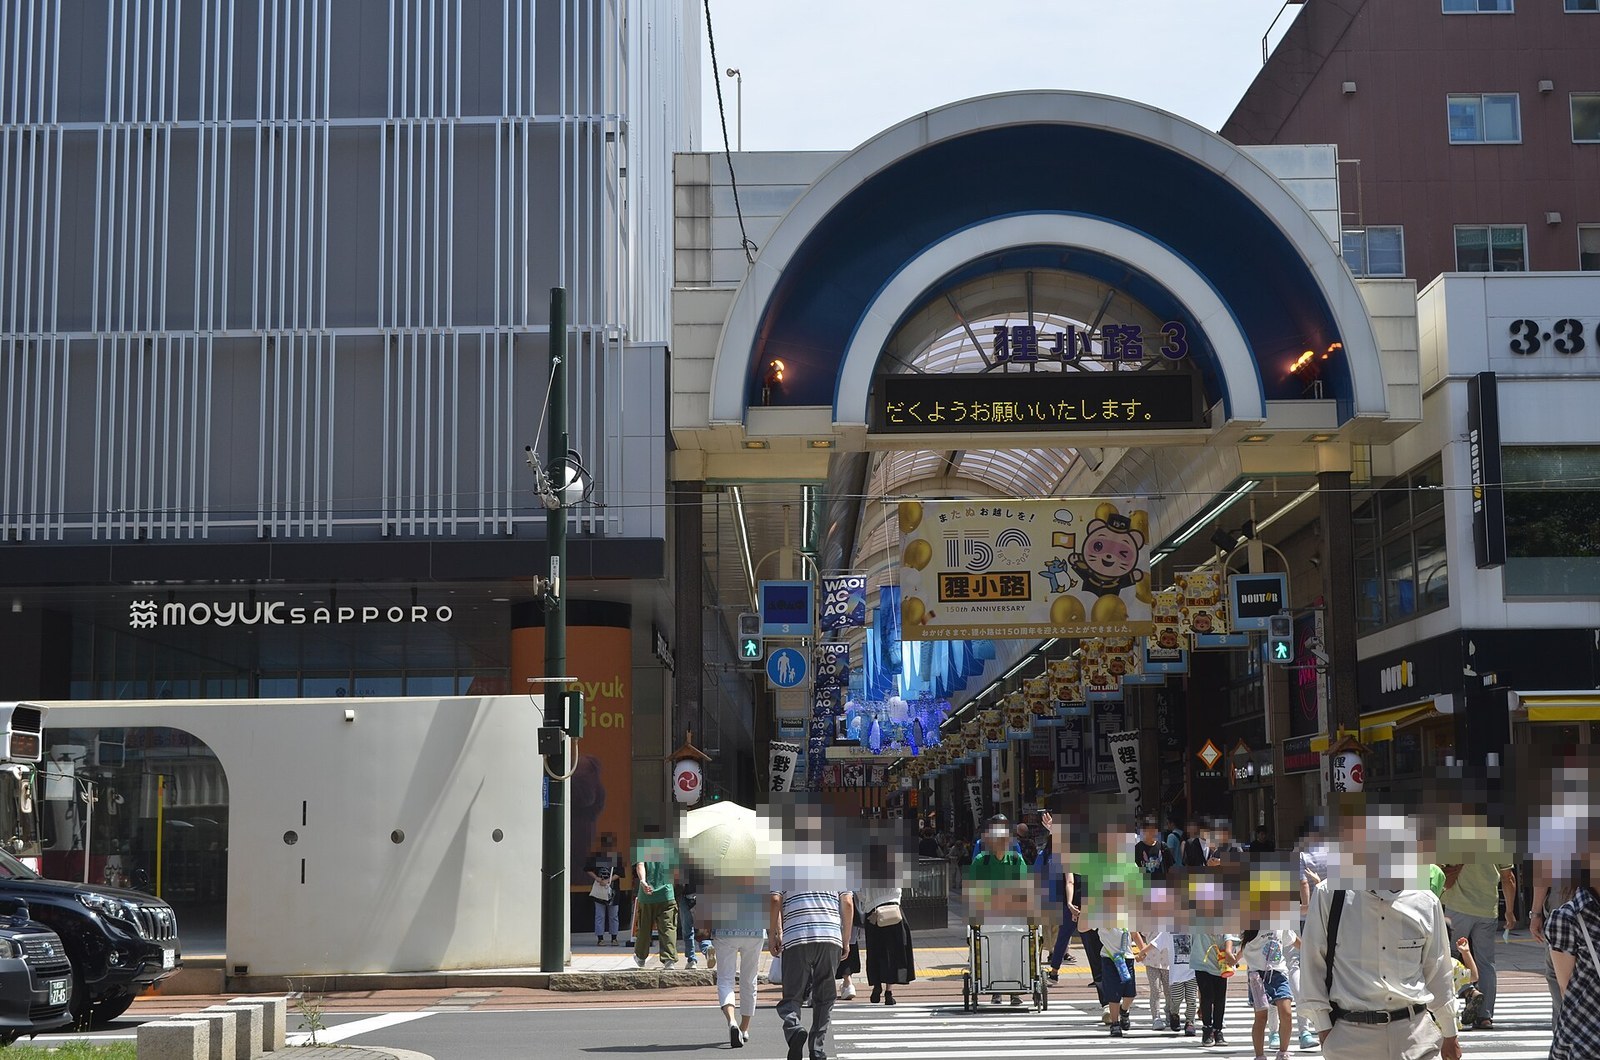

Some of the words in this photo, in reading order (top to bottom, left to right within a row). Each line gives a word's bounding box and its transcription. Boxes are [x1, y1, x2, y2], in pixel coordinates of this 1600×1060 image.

[993, 324, 1144, 364] 狸小路
[1160, 321, 1189, 361] 3
[943, 528, 1032, 572] 150
[824, 578, 864, 592] WAO!
[945, 575, 1025, 599] 狸小路
[825, 590, 850, 605] AC
[1241, 592, 1279, 604] DOUTOR
[291, 605, 453, 625] SAPPORO
[824, 603, 849, 616] AO
[971, 605, 1026, 613] ANNIVERSARY
[782, 624, 790, 633] 3
[1257, 617, 1265, 627] 3
[1219, 636, 1227, 644] 3
[818, 665, 836, 676] AO
